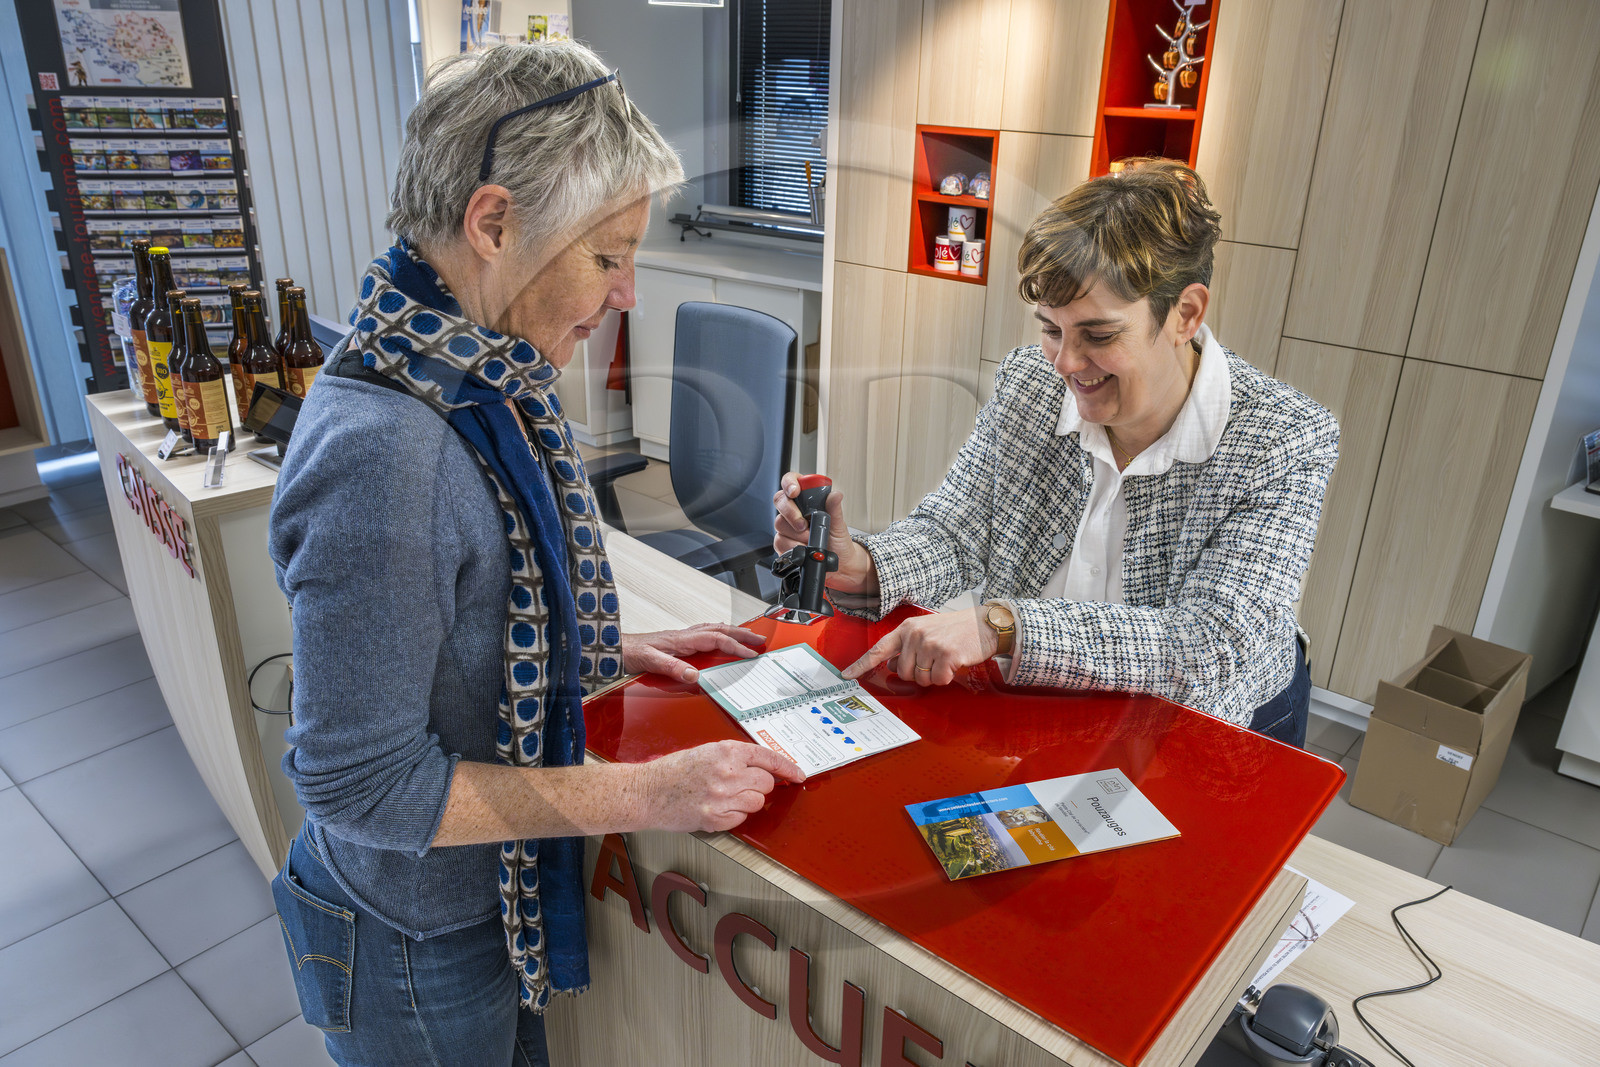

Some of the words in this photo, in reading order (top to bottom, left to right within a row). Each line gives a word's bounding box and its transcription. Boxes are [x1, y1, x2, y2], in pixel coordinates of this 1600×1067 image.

[49, 98, 118, 378] www.vendee-tourisme.com
[156, 367, 168, 376] BIO
[116, 452, 195, 579] CAISSE
[1086, 796, 1128, 838] Pouzauges
[590, 833, 972, 1067] ACCUE
